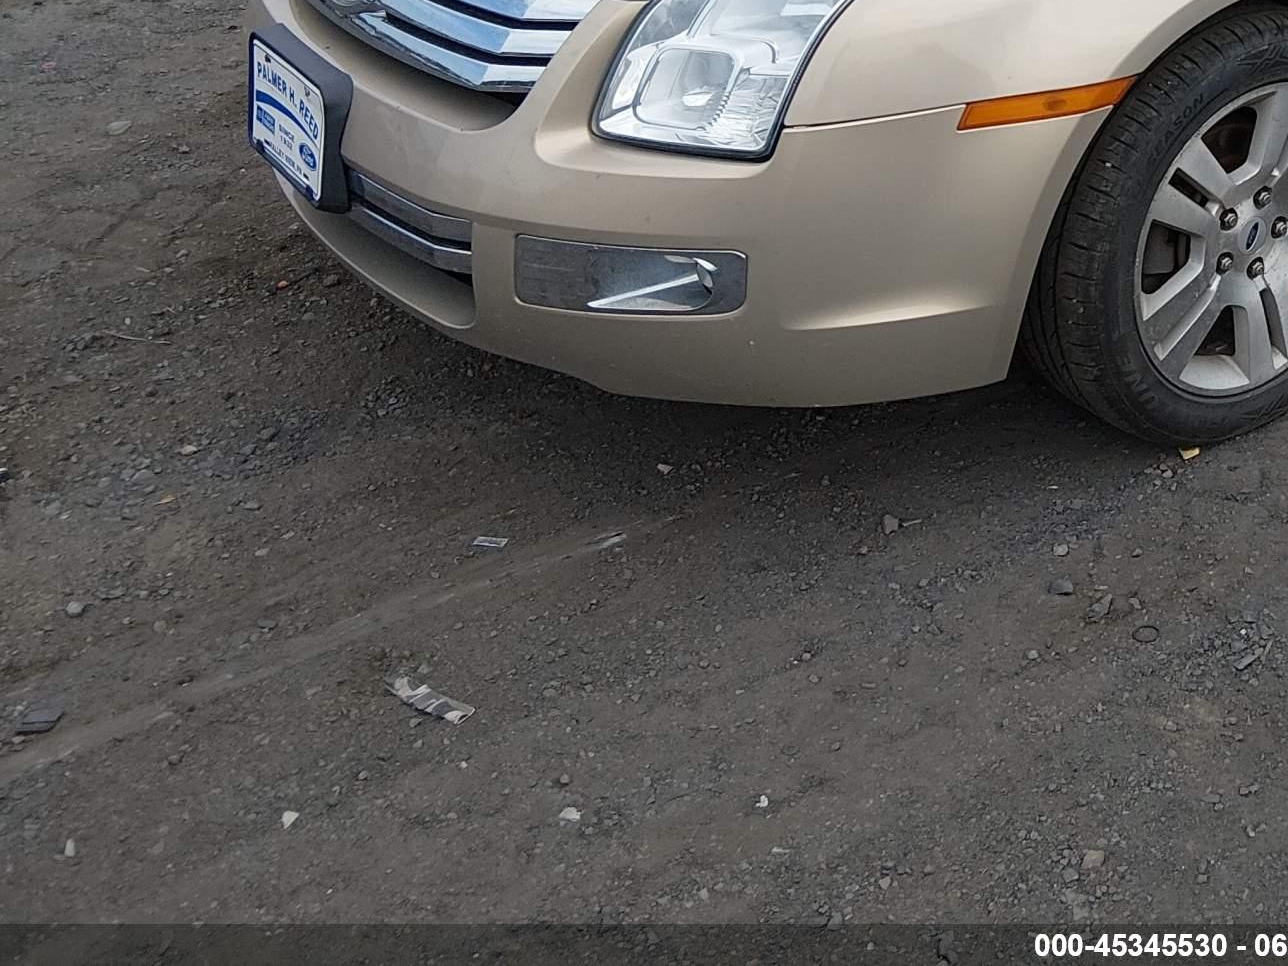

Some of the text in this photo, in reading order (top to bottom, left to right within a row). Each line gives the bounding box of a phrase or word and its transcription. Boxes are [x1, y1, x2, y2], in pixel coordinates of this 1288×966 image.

[257, 61, 288, 98] PALMER
[289, 86, 298, 108] H.
[299, 99, 319, 140] REED
